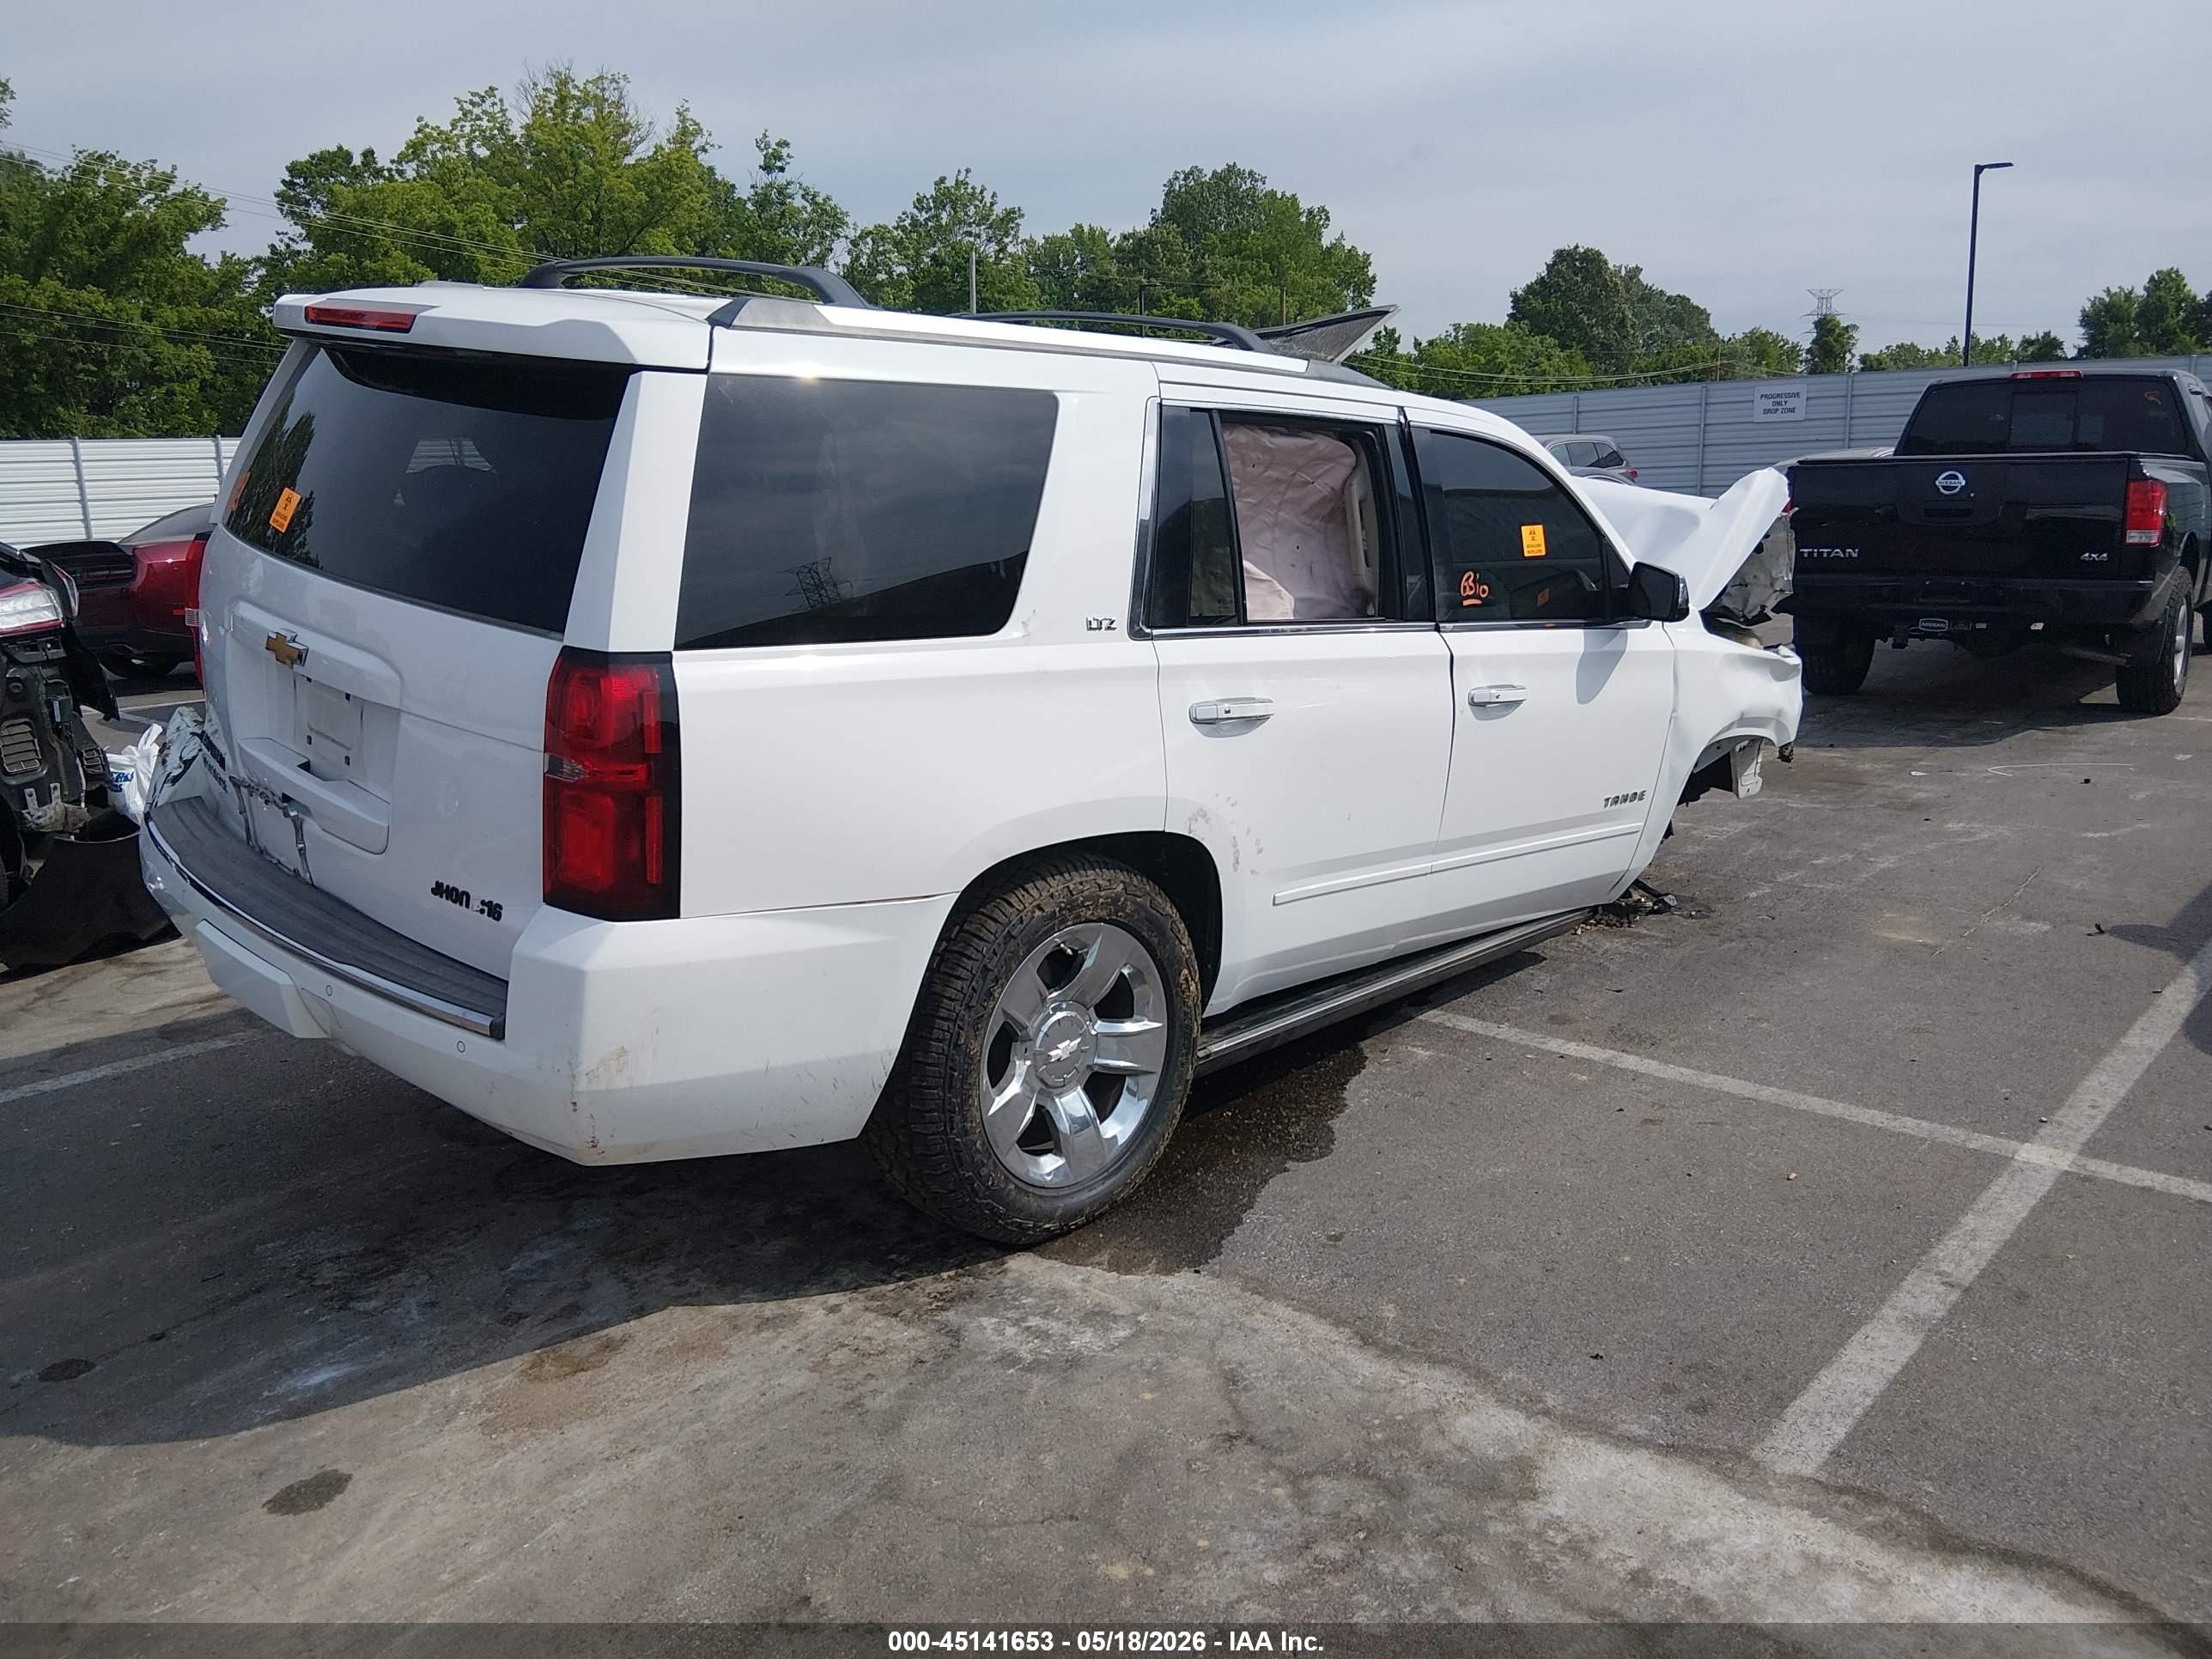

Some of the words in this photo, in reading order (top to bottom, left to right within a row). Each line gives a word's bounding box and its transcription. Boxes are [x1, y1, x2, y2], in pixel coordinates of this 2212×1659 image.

[1759, 392, 1801, 400] PROGRESSIVE
[1799, 549, 1859, 558] TITAN
[1085, 617, 1117, 631] LTZ
[1603, 790, 1647, 809] TAHOE
[430, 880, 471, 909] JHON
